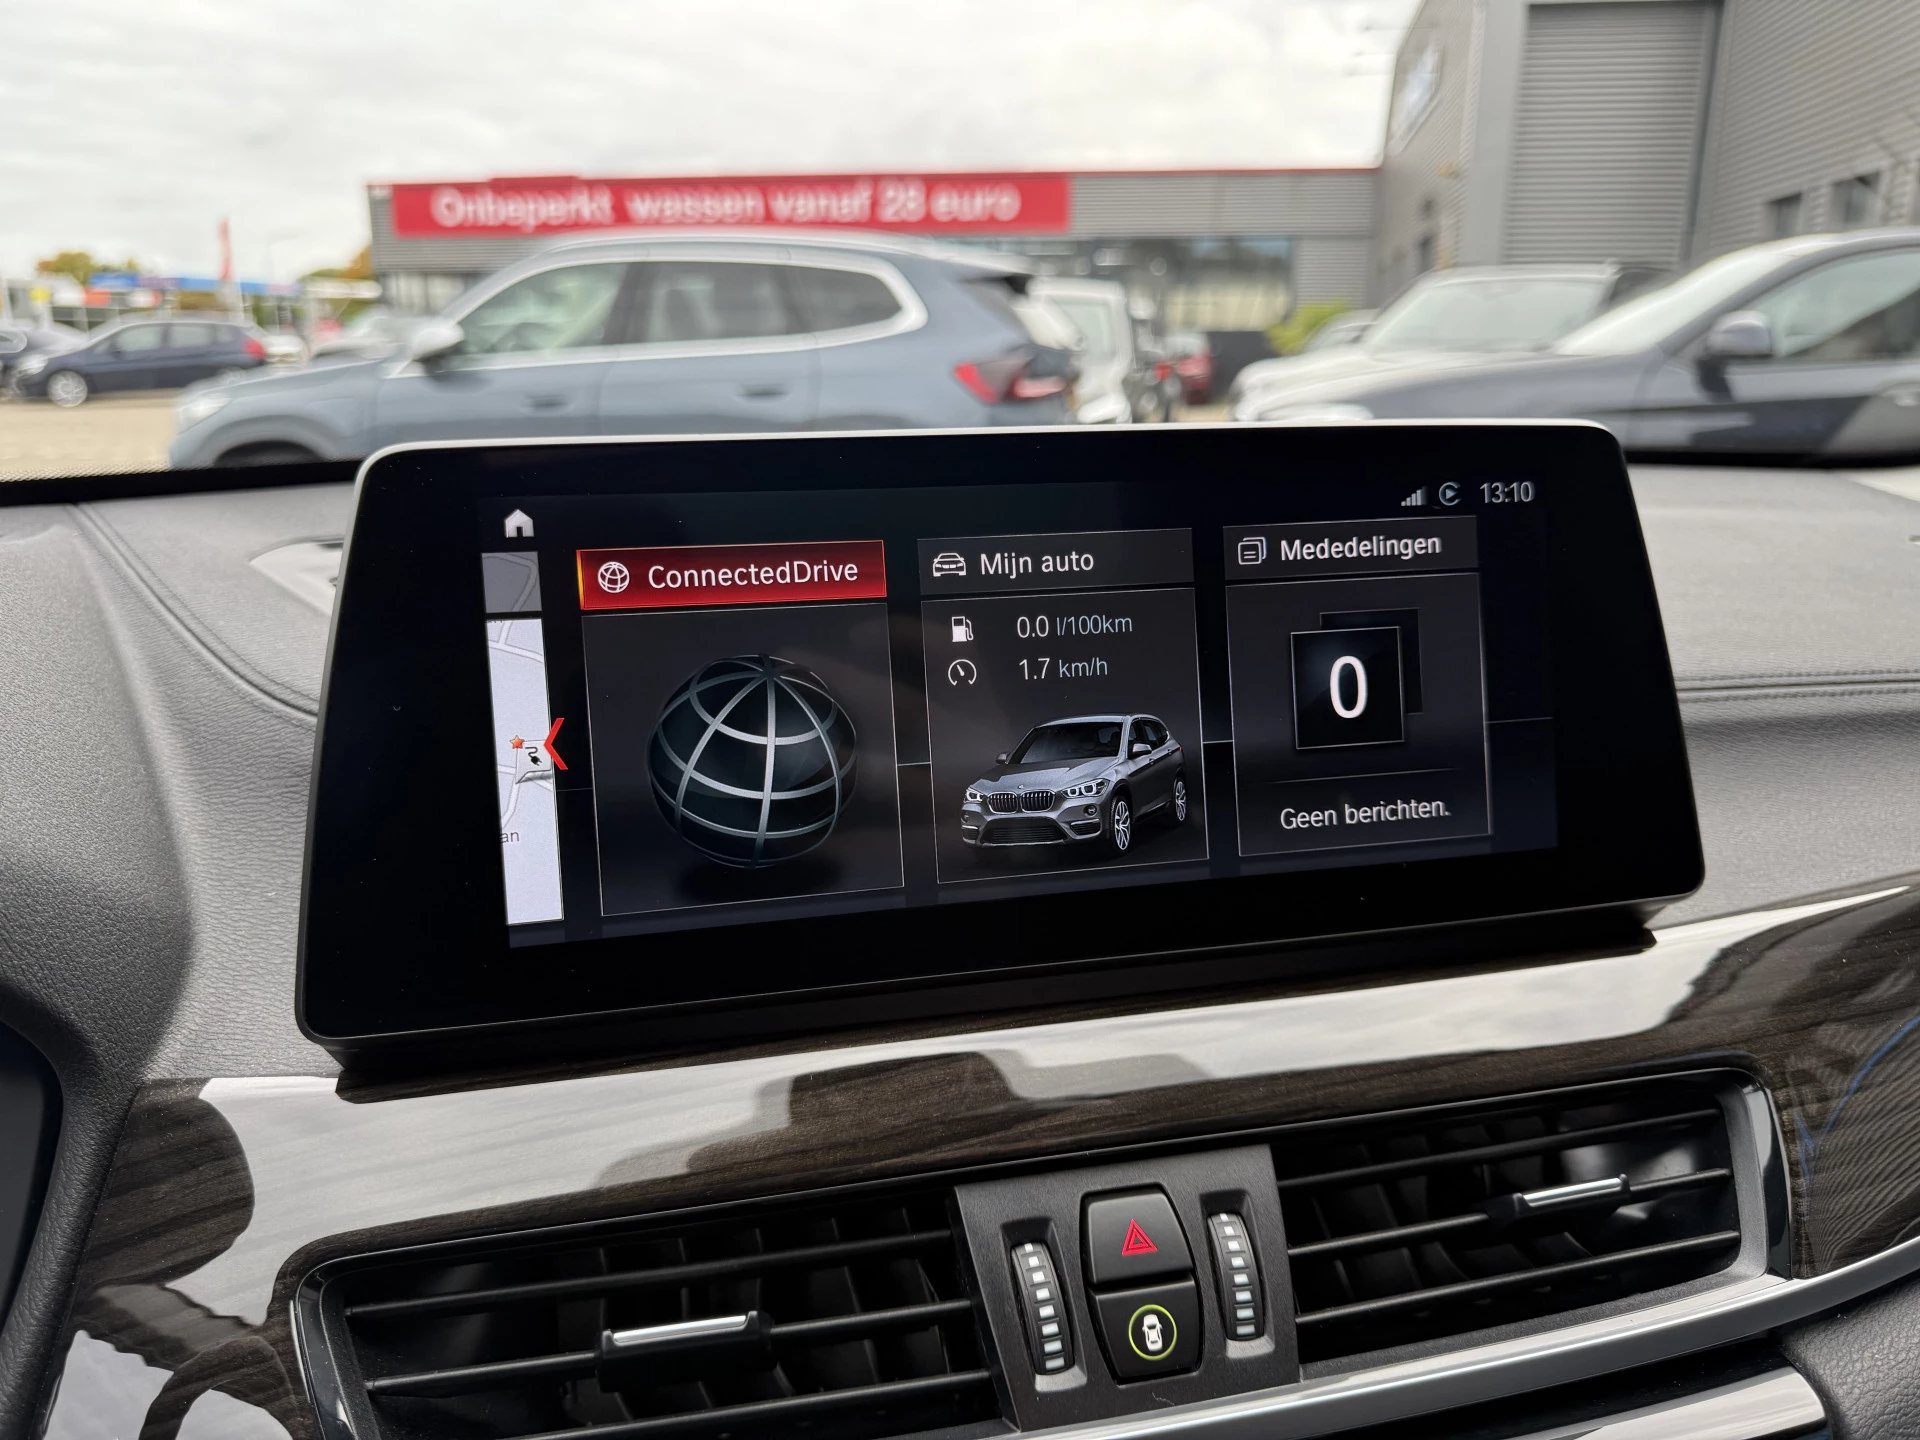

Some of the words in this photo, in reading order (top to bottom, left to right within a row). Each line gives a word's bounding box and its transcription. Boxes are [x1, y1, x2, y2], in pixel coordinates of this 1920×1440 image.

[430, 183, 612, 233] Onbeperkt
[626, 185, 766, 221] wassen
[769, 178, 871, 222] vanaf
[930, 183, 1022, 222] euro
[1480, 481, 1535, 504] 13:10
[1280, 535, 1442, 561] Mededelingen
[648, 560, 859, 590] ConnectedDrive
[980, 552, 1032, 579] Mijn
[1041, 551, 1094, 573] auto
[1016, 615, 1050, 638] 0.0
[1056, 614, 1133, 636] l/100km
[1019, 657, 1050, 680] 1.7
[1059, 657, 1108, 678] km/h
[1329, 655, 1368, 719] 0
[1280, 808, 1338, 829] Geen
[1344, 799, 1451, 824] berichten.
